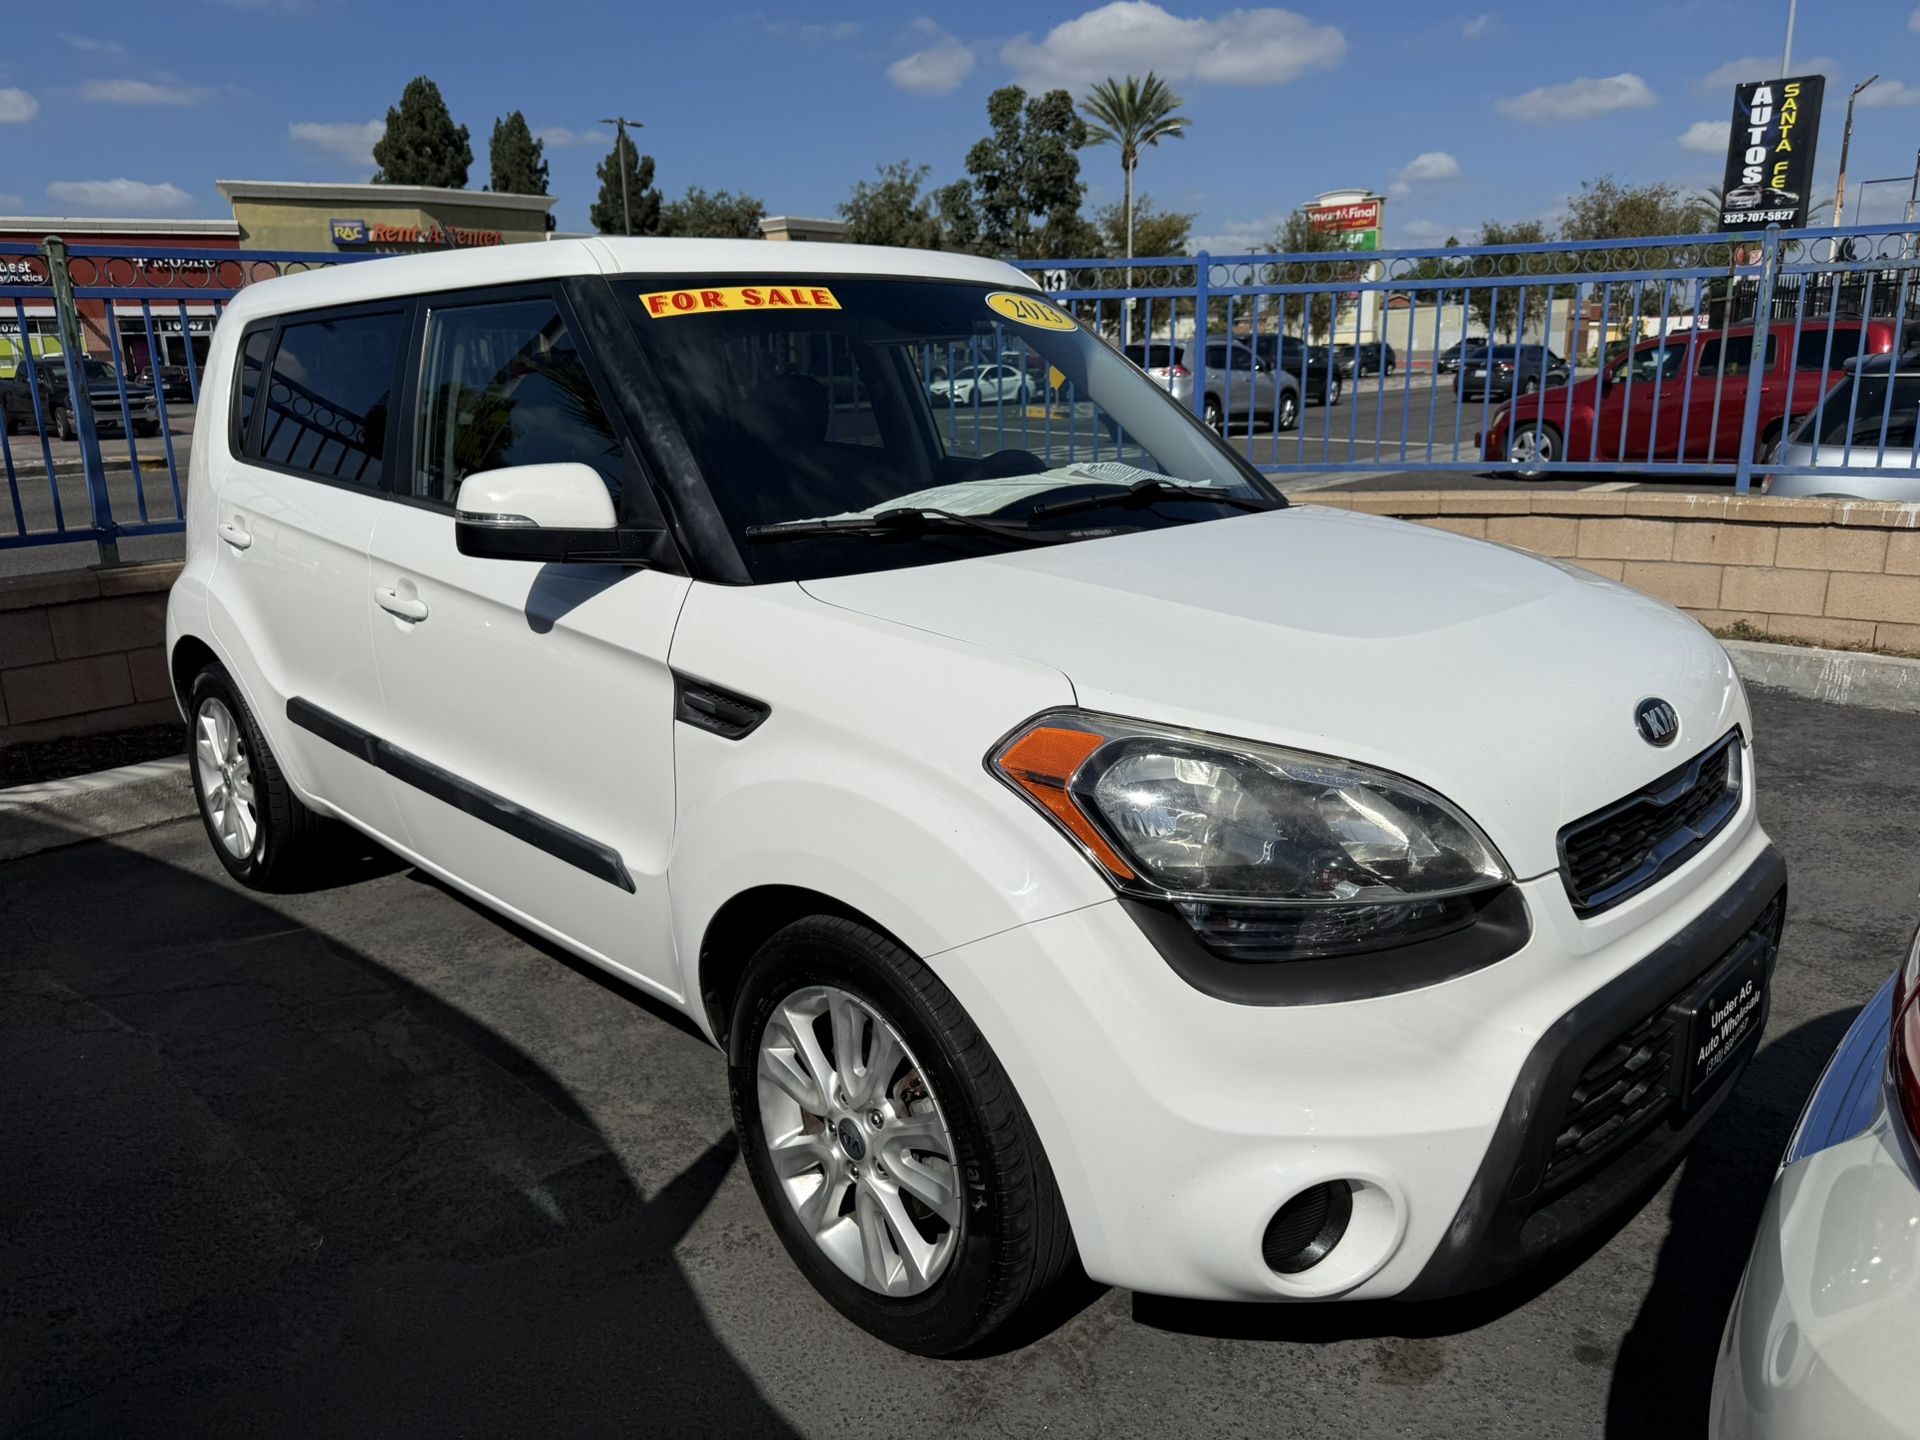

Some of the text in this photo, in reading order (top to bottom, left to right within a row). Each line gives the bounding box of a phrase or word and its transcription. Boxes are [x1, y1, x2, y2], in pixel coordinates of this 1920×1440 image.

[1742, 86, 1773, 184] AUTOS
[1771, 83, 1800, 189] SANTA FE
[1724, 211, 1793, 224] 323-707-5827
[335, 226, 362, 241] RAC
[647, 287, 830, 315] FOR SALE
[1004, 298, 1064, 325] 2013
[166, 320, 204, 331] 1047
[1642, 703, 1678, 739] KIA
[1711, 980, 1753, 1028] Under AG
[1697, 1037, 1720, 1066] Auto
